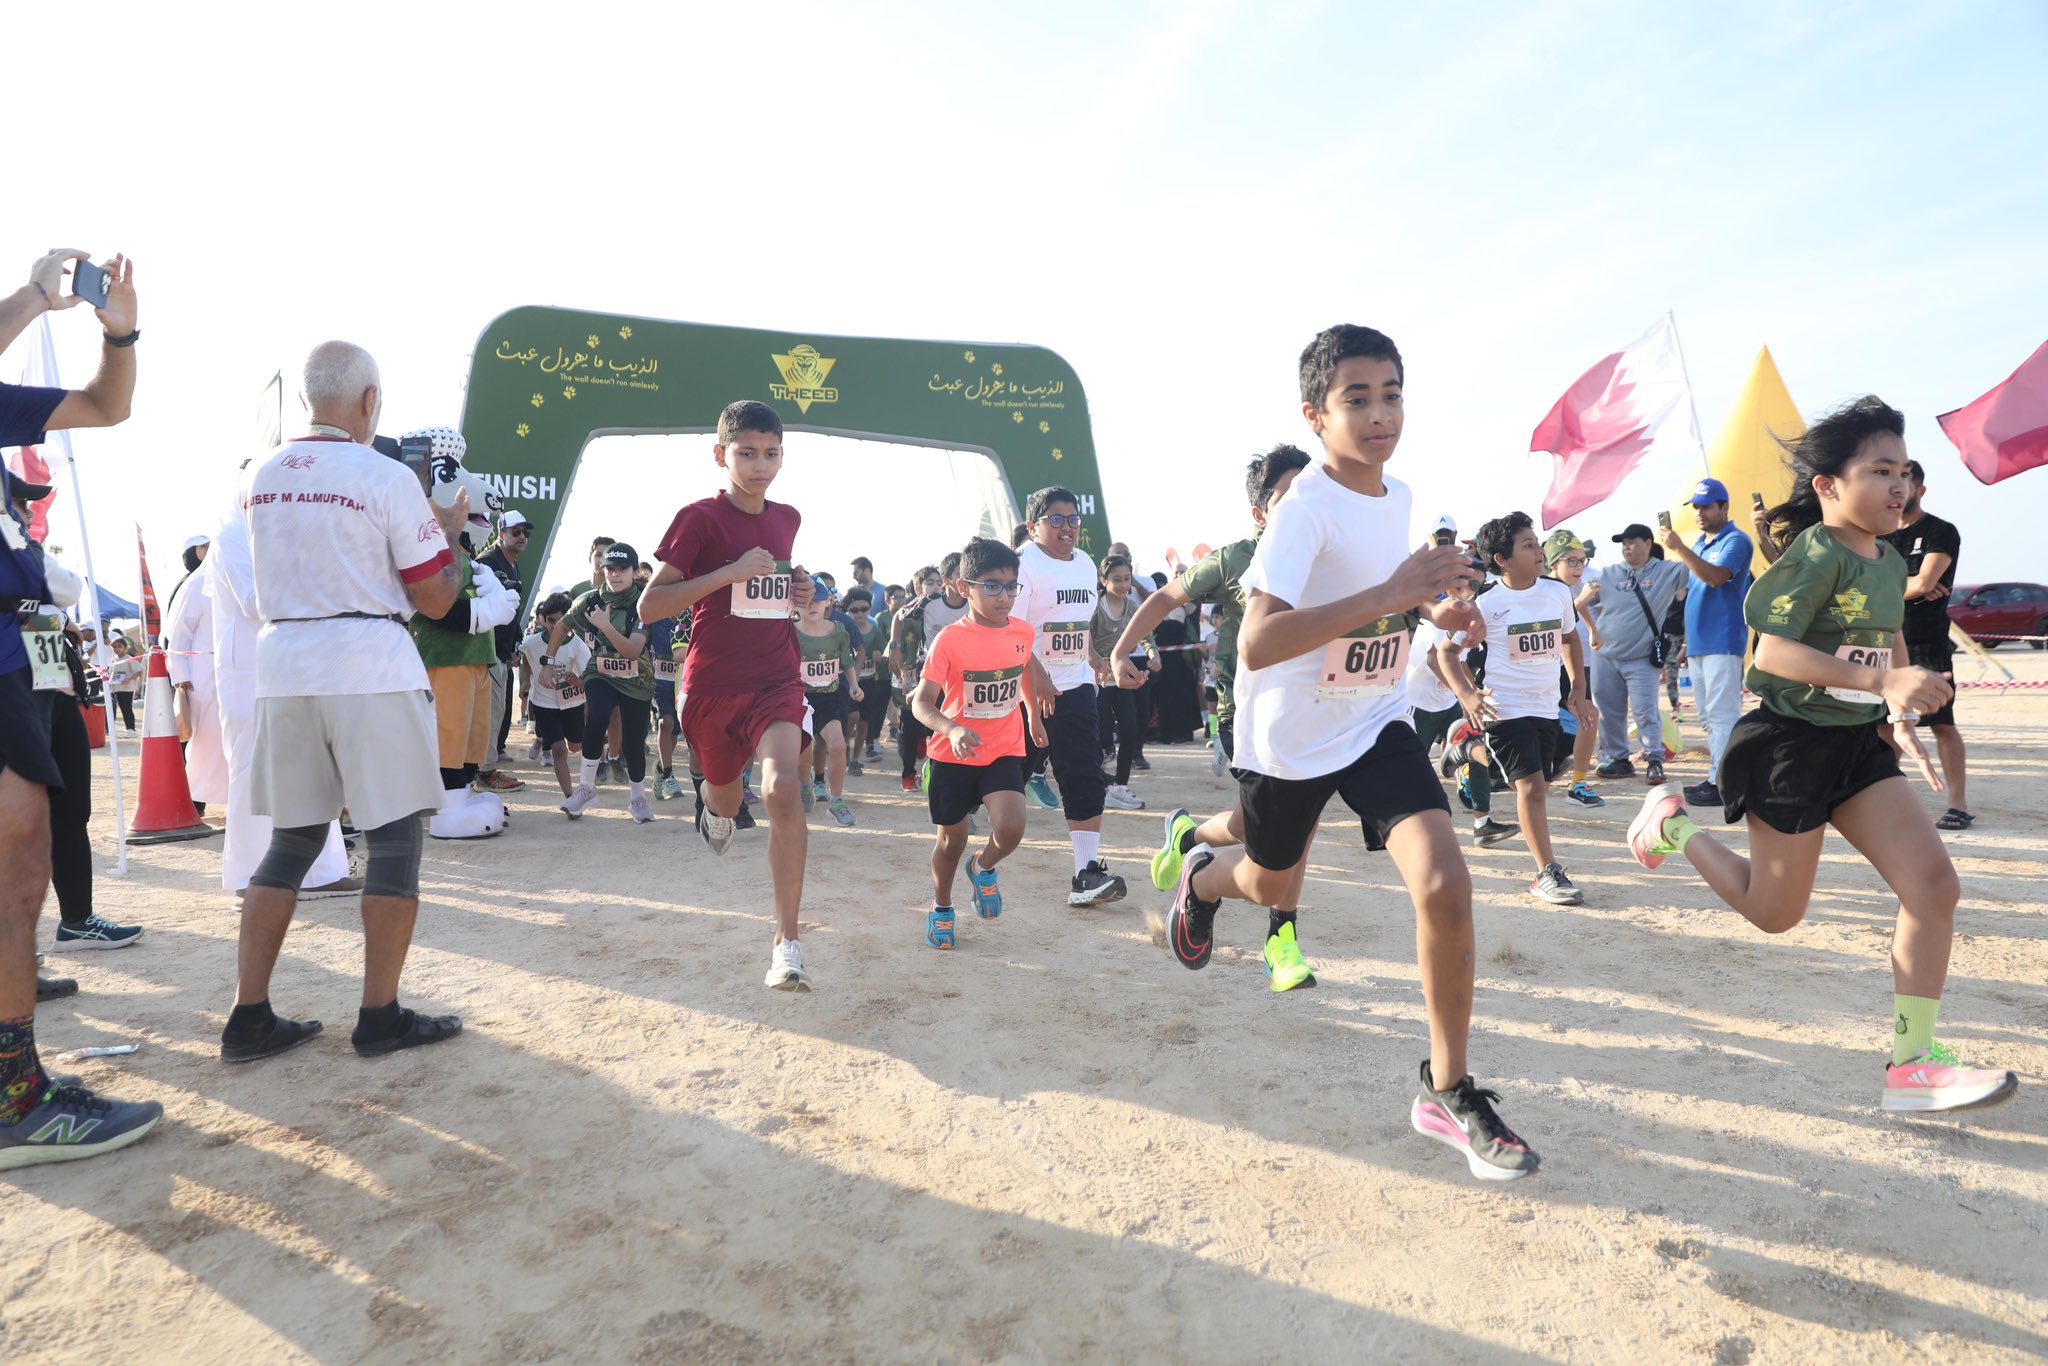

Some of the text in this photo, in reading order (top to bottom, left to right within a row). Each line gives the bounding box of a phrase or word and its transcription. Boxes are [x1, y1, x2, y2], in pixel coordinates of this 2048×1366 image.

[496, 340, 539, 365] عبث
[540, 347, 589, 373] يهرول
[593, 353, 605, 368] ما
[559, 373, 660, 392] The wolf doesn't run aimlessly
[928, 373, 964, 395] عبث
[964, 375, 1005, 400] يهرول
[1008, 381, 1018, 393] ما
[769, 383, 839, 403] THEEB
[982, 399, 992, 407] The
[470, 473, 557, 500] INISH
[281, 493, 293, 502] M
[297, 493, 366, 512] ALMUFTAH
[604, 550, 628, 559] adidas
[746, 576, 790, 600] 6067
[1056, 589, 1089, 605] PUMA
[1767, 614, 1789, 625] TRAILS
[1829, 606, 1872, 619] THEEB
[1052, 633, 1084, 651] 6016
[1518, 631, 1555, 653] 6018
[1345, 635, 1401, 674] 6017
[603, 659, 632, 671] 6051
[807, 661, 836, 677] 6031
[973, 679, 1018, 704] 6028
